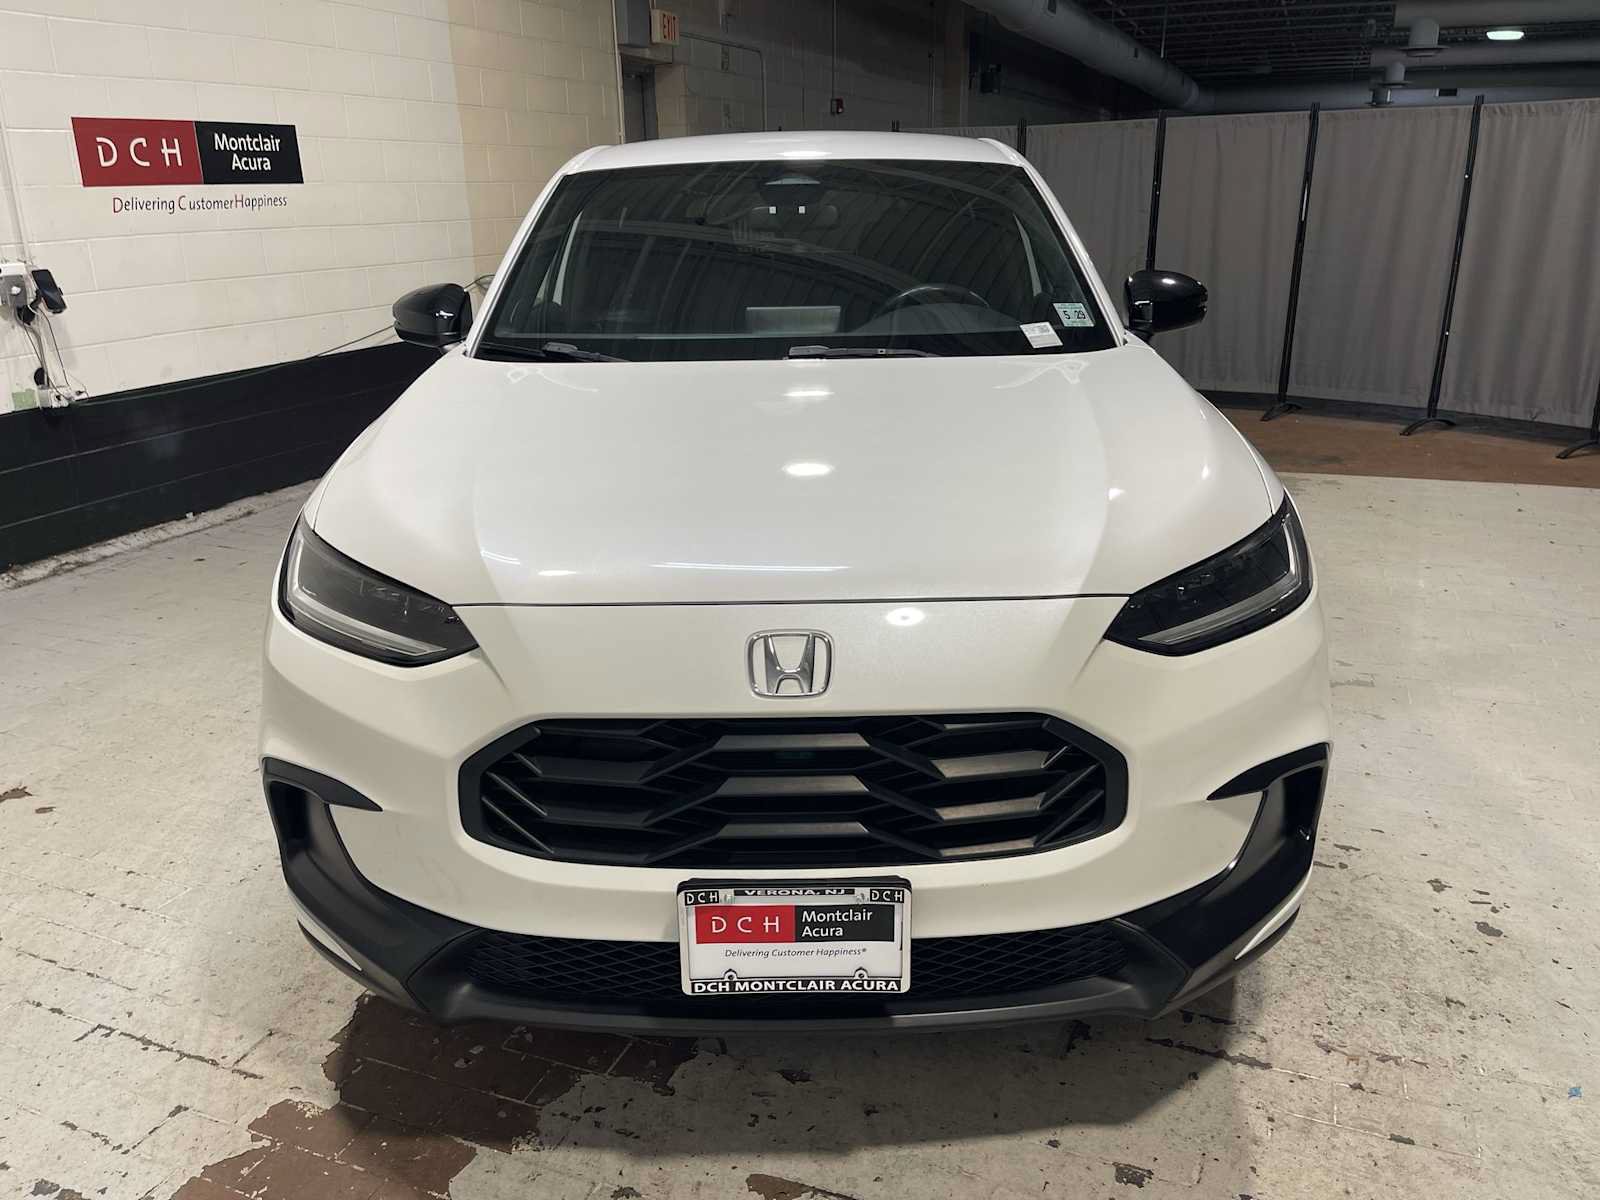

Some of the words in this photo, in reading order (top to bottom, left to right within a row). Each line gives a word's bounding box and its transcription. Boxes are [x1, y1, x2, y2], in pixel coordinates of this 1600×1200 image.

[662, 13, 678, 40] EXIT
[214, 132, 281, 152] Montclair
[231, 153, 271, 171] Acura
[112, 196, 175, 215] Delivering
[178, 195, 234, 212] Customer
[235, 193, 288, 211] Happiness
[1063, 310, 1071, 320] 5
[1074, 310, 1087, 320] 29
[686, 891, 719, 905] DCH
[824, 888, 845, 896] NJ
[871, 889, 904, 902] DCH
[802, 909, 873, 923] Montclair
[802, 925, 844, 938] Acura
[724, 948, 769, 959] Delivering
[771, 948, 814, 958] Customer
[693, 983, 730, 994] DCH
[735, 980, 837, 992] MONTCLAIR
[841, 979, 899, 992] ACURA
